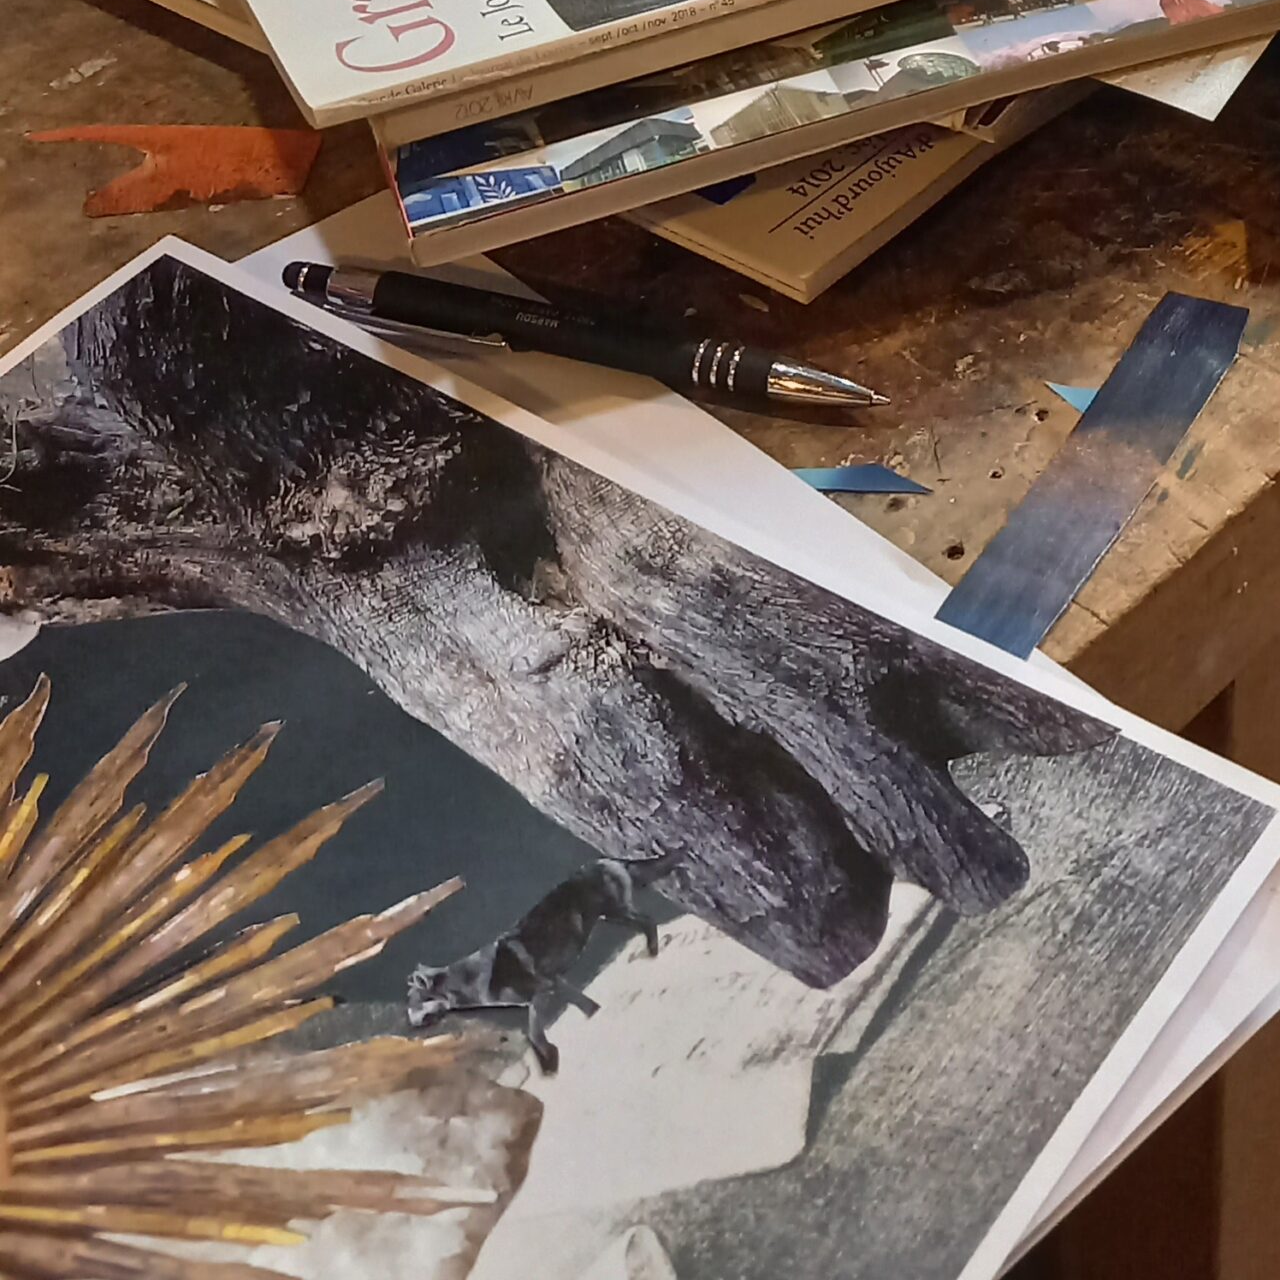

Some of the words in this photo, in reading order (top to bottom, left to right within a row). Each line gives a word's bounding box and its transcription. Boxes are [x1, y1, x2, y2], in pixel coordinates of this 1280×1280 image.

[672, 5, 697, 22] 2018
[497, 15, 535, 41] Le
[786, 159, 846, 198] 2014
